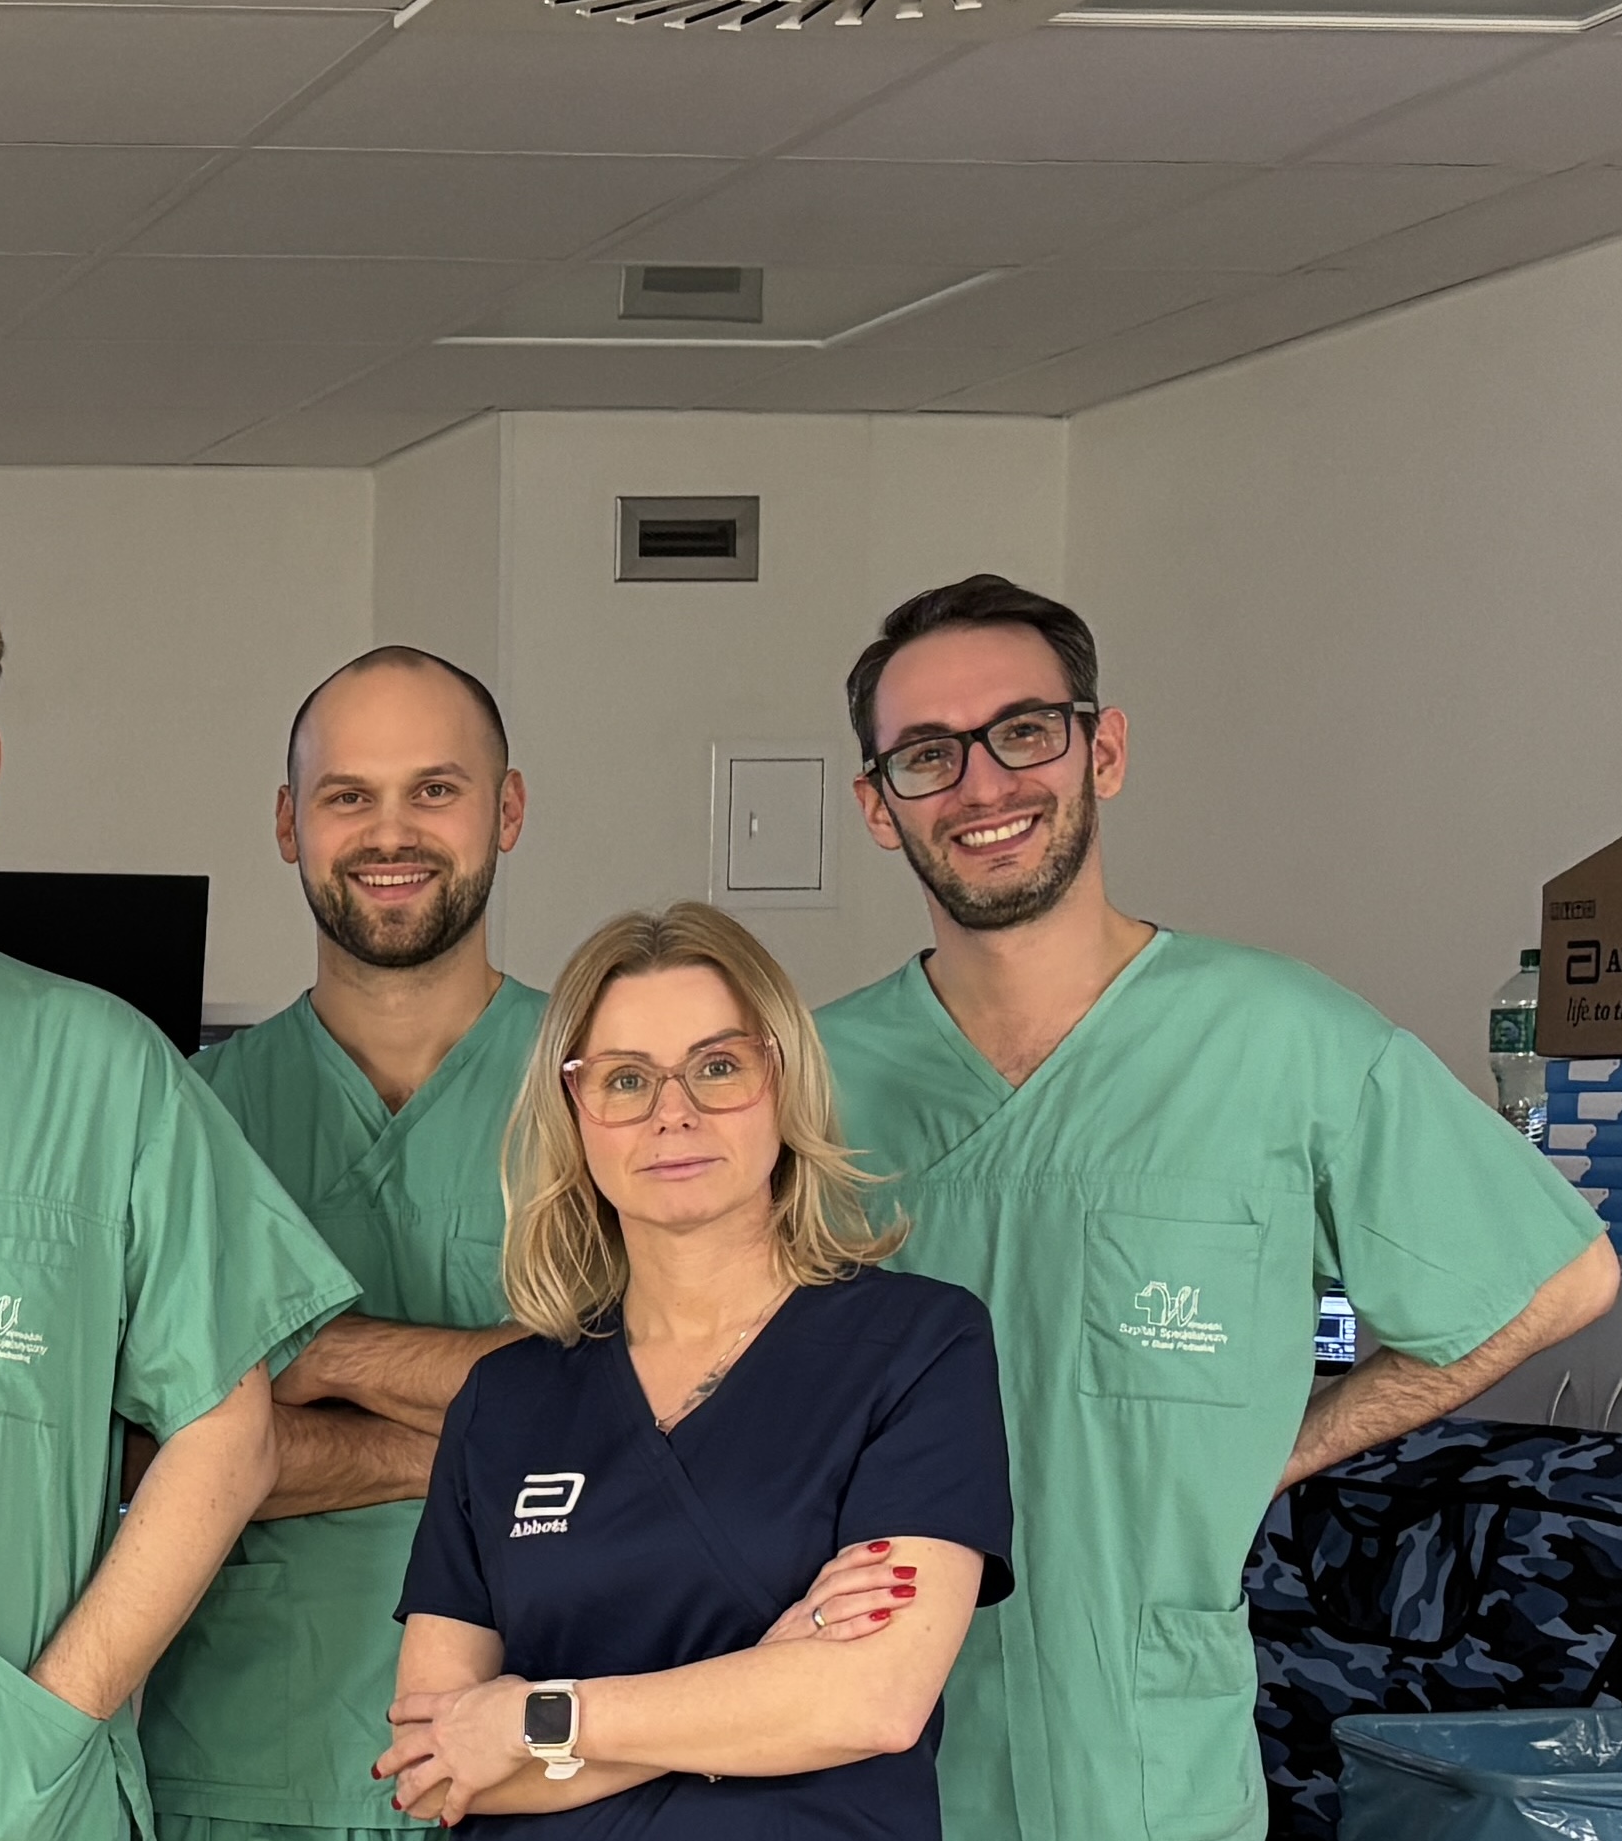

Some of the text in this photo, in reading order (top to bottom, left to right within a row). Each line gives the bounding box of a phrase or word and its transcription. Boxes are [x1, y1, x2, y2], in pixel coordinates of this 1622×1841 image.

[1605, 948, 1622, 973] A
[1594, 1001, 1611, 1021] to
[1614, 1000, 1622, 1021] t
[509, 1518, 568, 1538] Abbott
